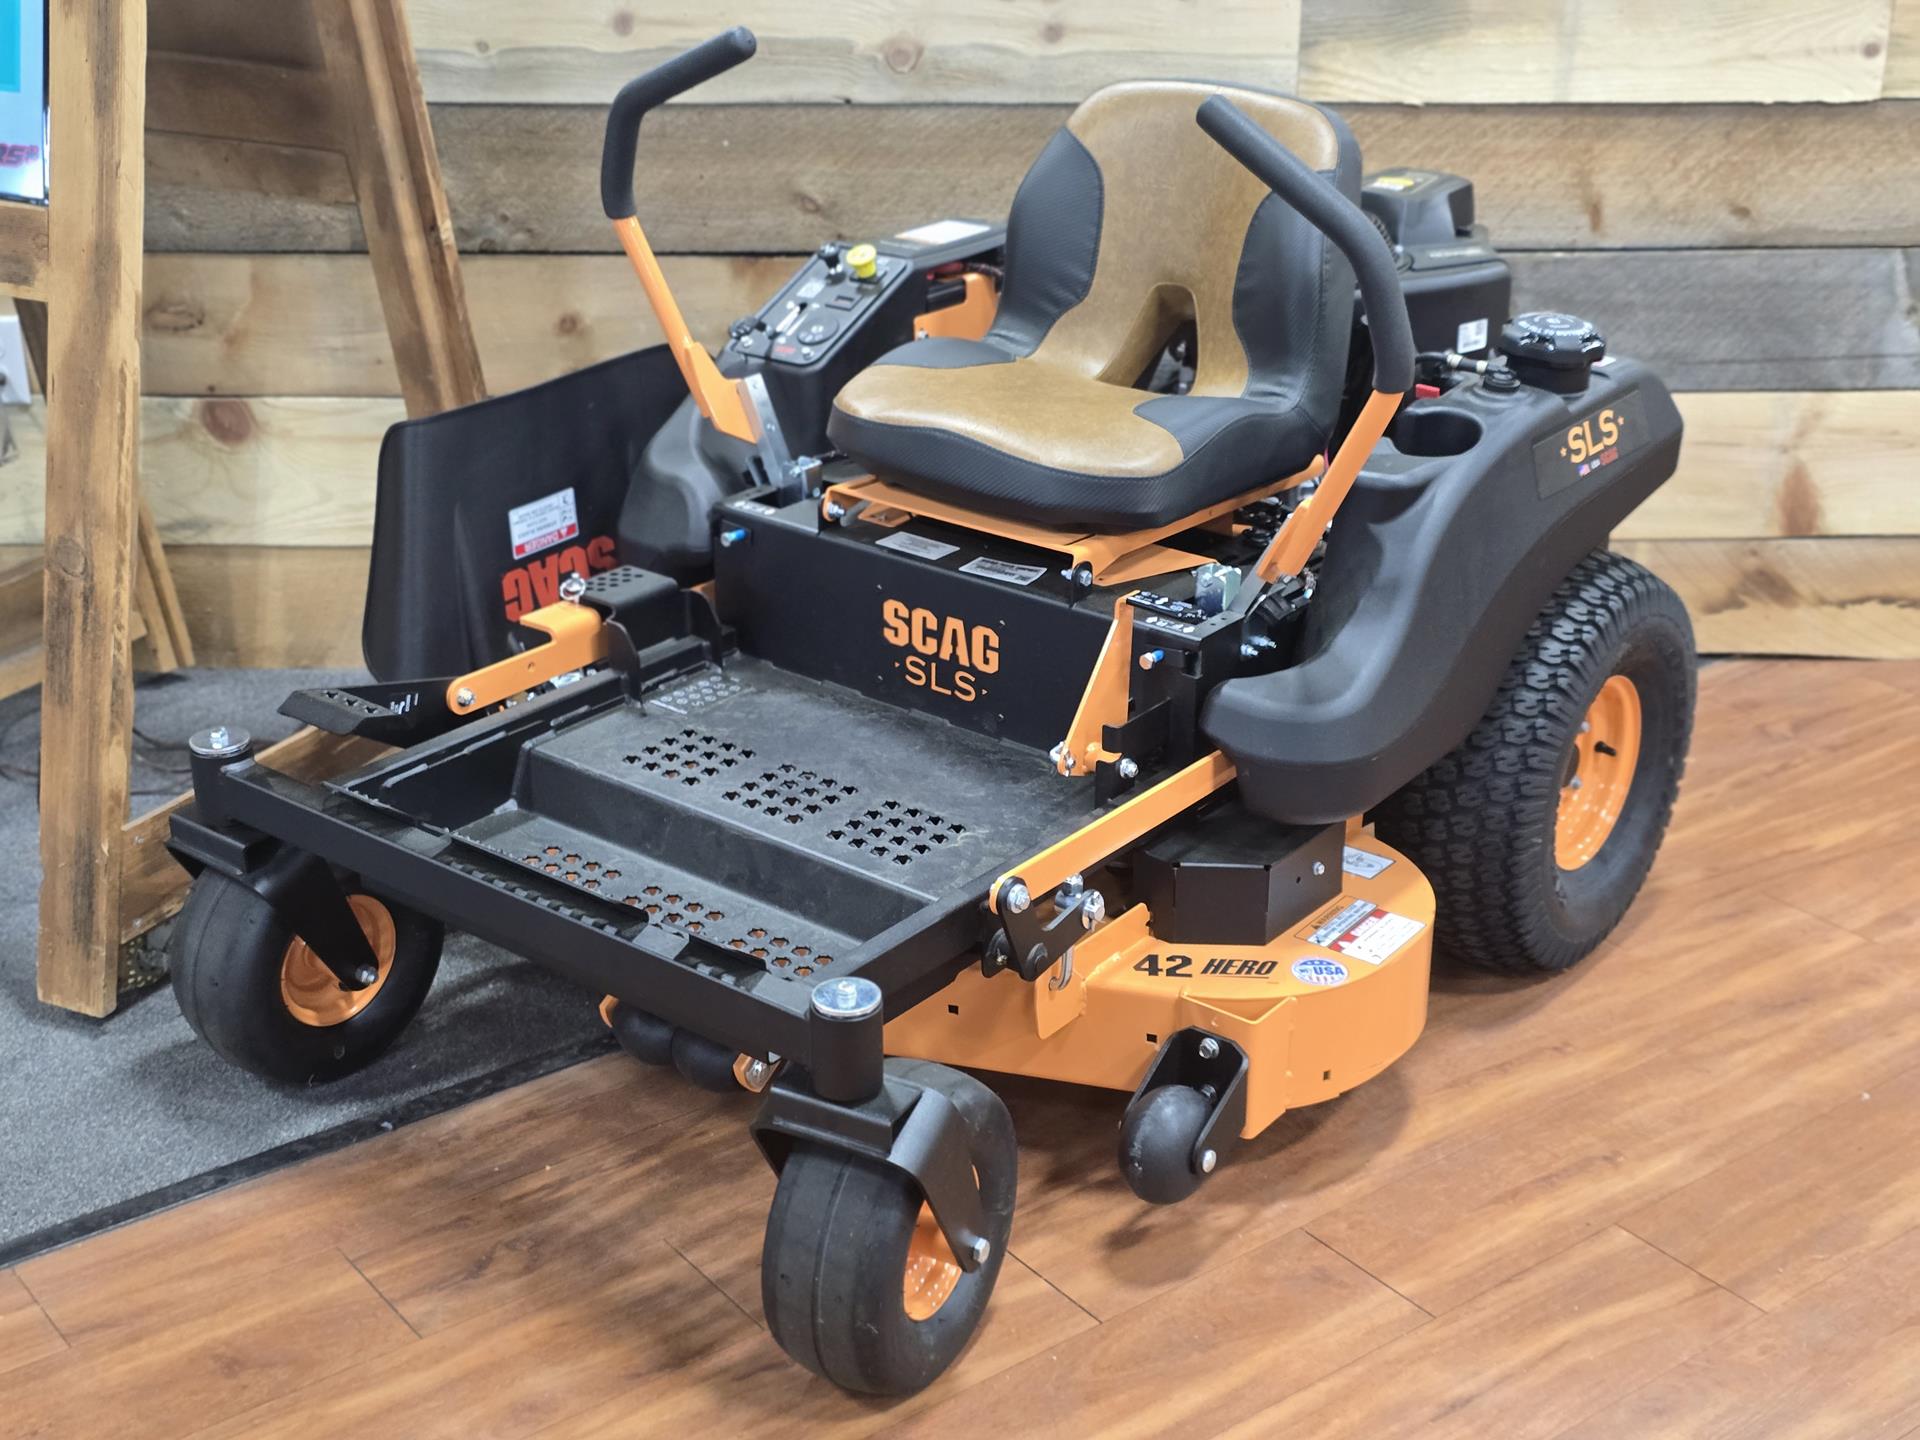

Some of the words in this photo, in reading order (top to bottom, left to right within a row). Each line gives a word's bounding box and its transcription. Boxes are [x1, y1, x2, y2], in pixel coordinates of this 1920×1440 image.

[1567, 409, 1619, 464] SLS
[882, 598, 1000, 674] SCAG
[904, 655, 976, 702] SLS
[1133, 954, 1193, 978] 42
[1200, 958, 1279, 976] HERO
[1313, 965, 1345, 977] USA
